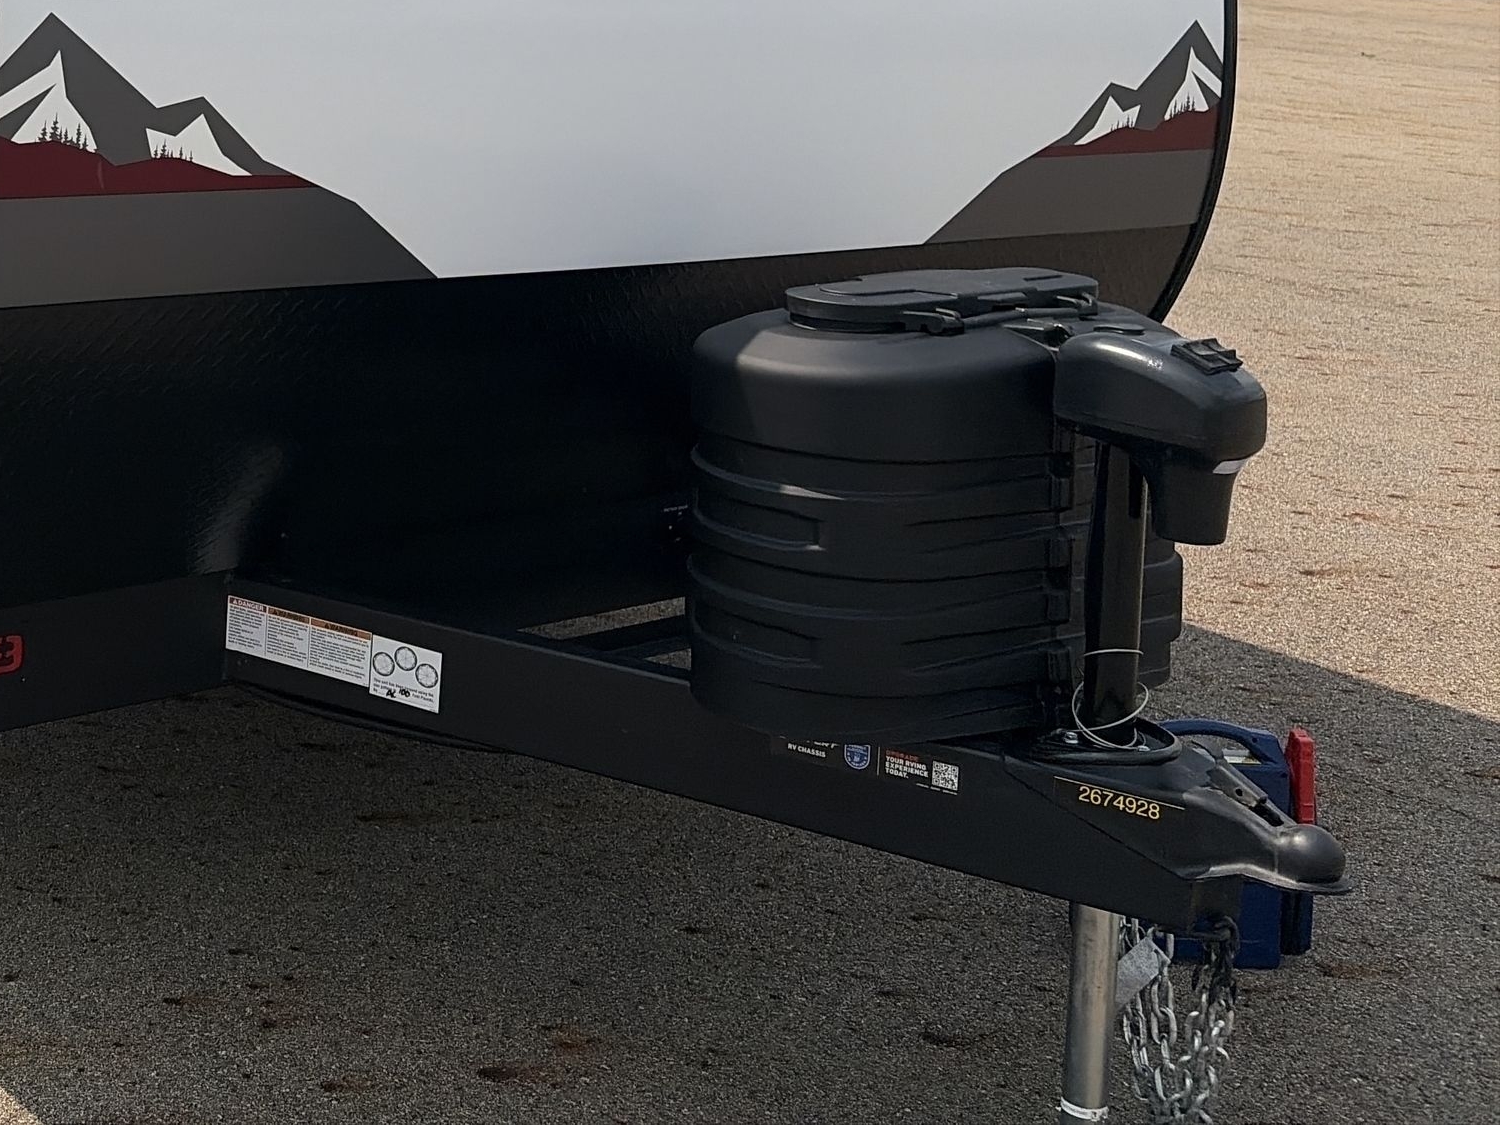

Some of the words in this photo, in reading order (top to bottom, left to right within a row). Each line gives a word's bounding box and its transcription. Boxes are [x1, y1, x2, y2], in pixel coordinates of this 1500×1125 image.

[788, 742, 796, 751] RV
[797, 745, 826, 758] CHASSIS
[885, 755, 904, 764] YOUR
[905, 760, 927, 771] RVING
[885, 761, 929, 778] EXPERIENCE
[885, 767, 909, 779] TODAY.
[1079, 786, 1160, 820] 2674928
